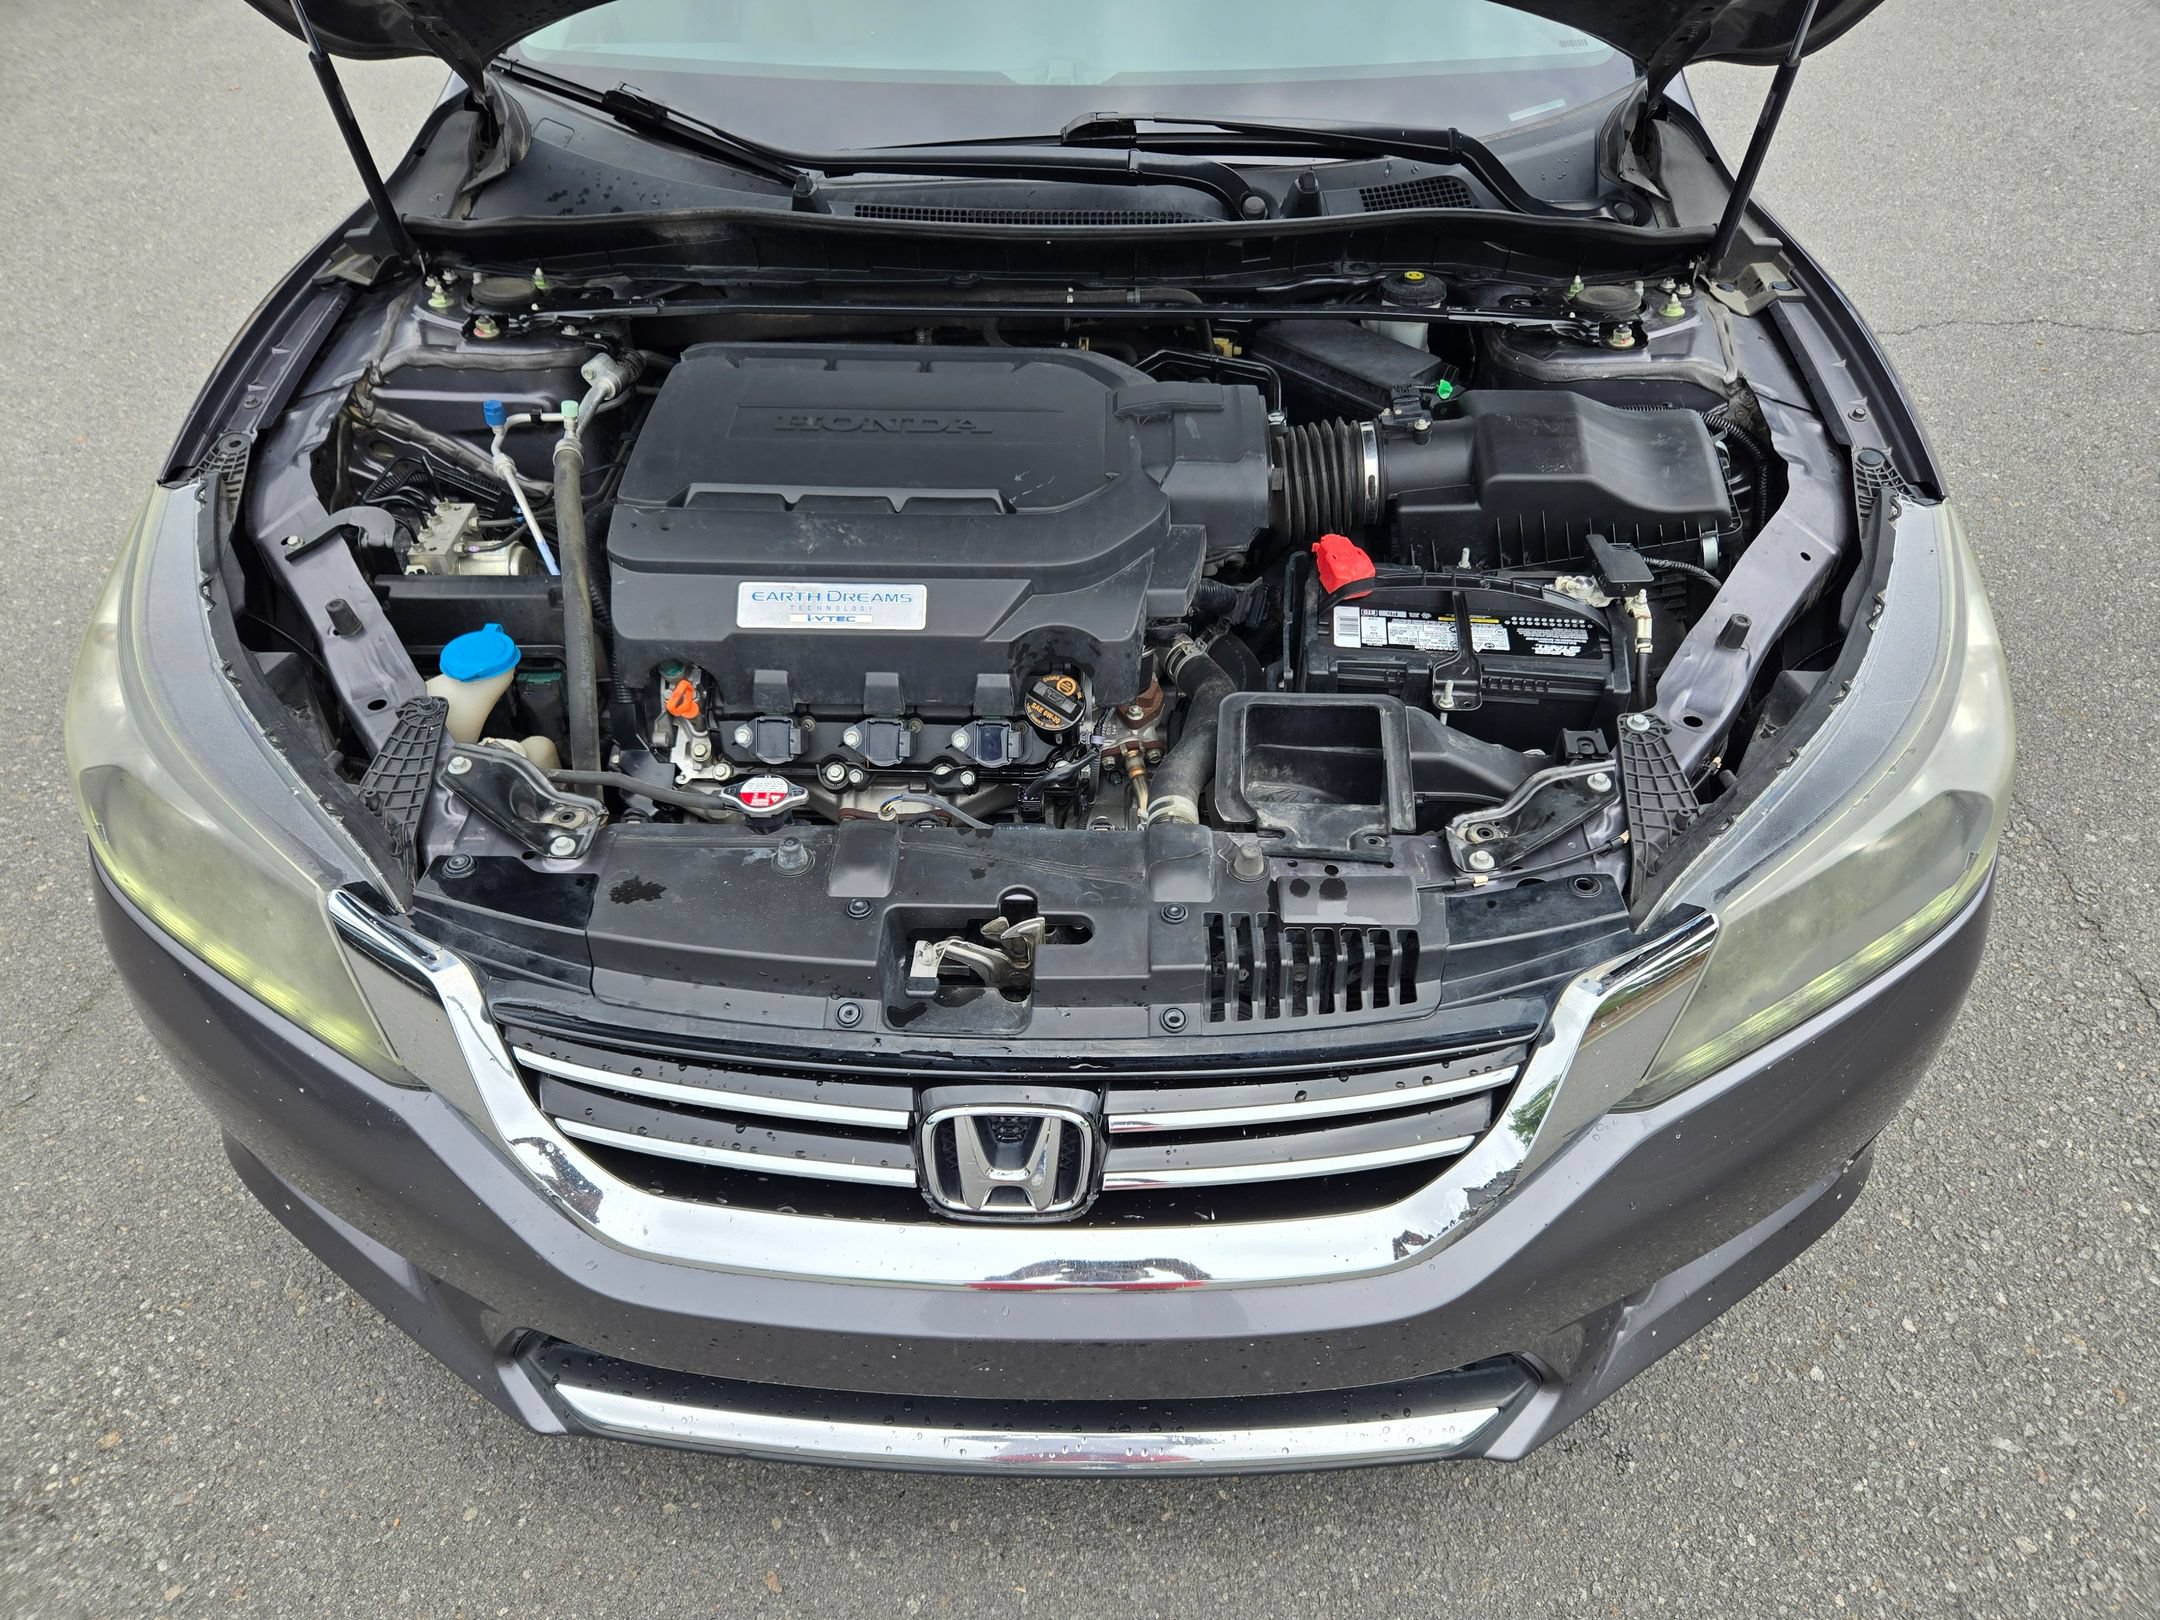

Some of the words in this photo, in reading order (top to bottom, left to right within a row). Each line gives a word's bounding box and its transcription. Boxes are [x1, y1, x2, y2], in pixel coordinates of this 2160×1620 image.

[773, 416, 993, 435] HONDA
[751, 590, 821, 602] EARTH
[827, 590, 912, 603] DREAMS
[790, 604, 873, 612] TECHNOLOGY
[1031, 702, 1043, 714] SAE
[1042, 710, 1061, 725] 0W-20
